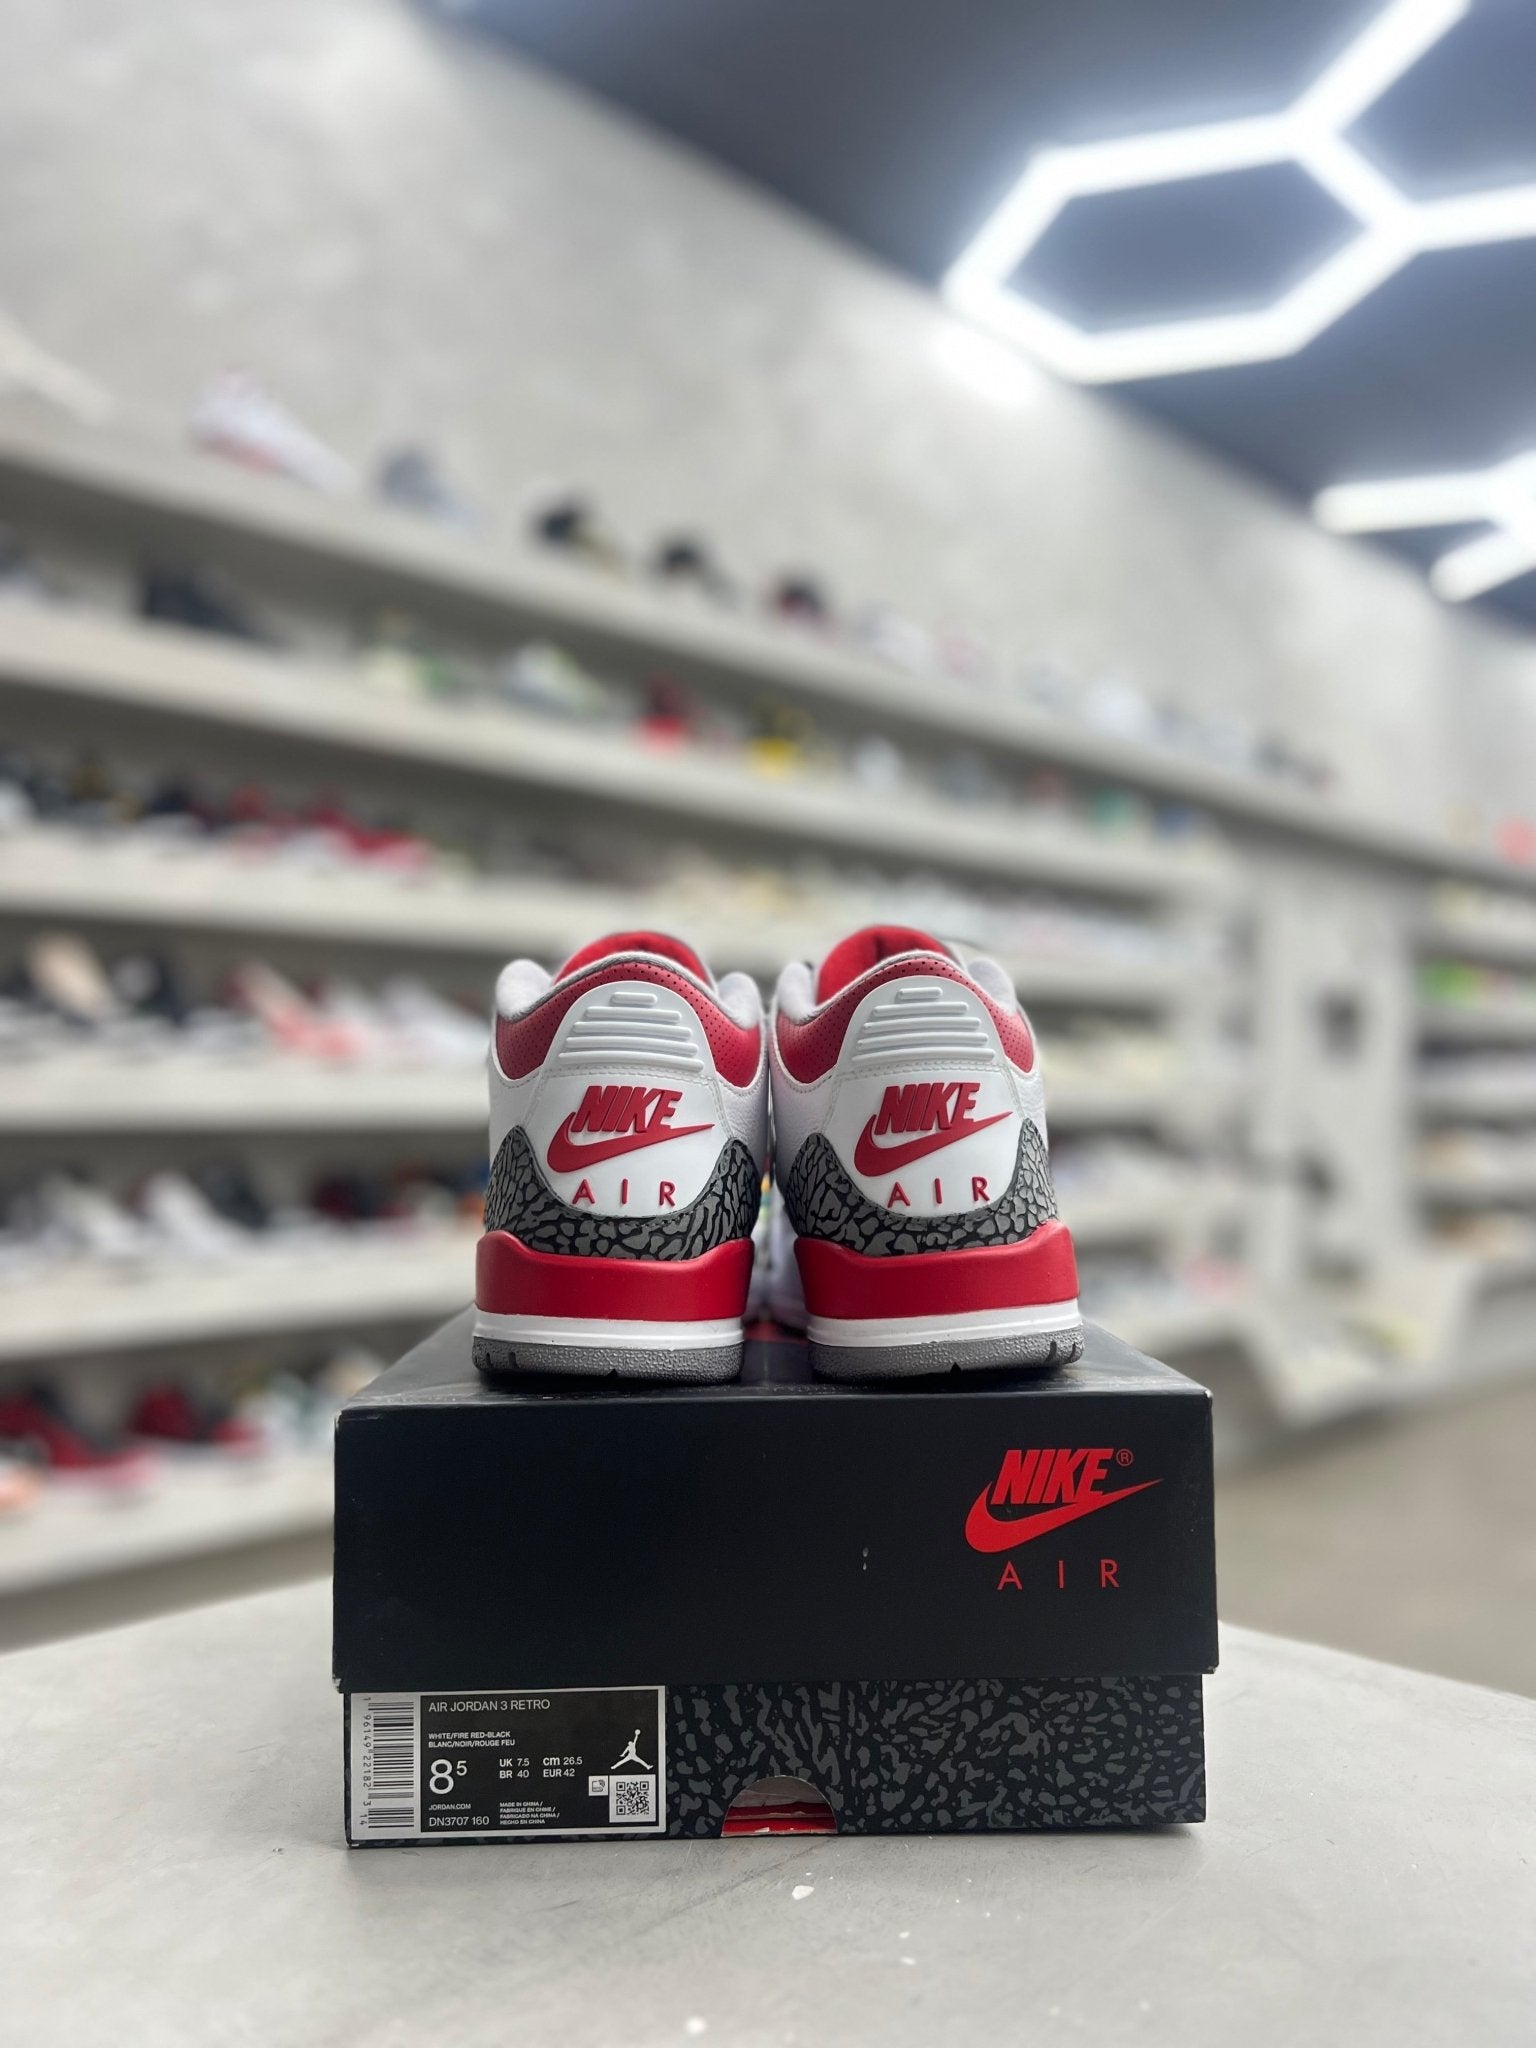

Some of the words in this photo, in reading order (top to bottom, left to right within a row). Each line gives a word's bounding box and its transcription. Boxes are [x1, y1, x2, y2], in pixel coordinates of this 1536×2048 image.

[571, 1085, 683, 1134] NIKE
[874, 1082, 981, 1135] NIKE
[571, 1178, 676, 1207] AIR
[887, 1176, 990, 1209] AIR
[996, 1559, 1120, 1591] AIR
[428, 1701, 448, 1713] AIR
[450, 1700, 498, 1712] JORDAN
[500, 1700, 508, 1711] 3
[510, 1699, 551, 1711] RETRO
[470, 1731, 511, 1739] RED-BLACK
[499, 1758, 513, 1767] UK
[542, 1757, 561, 1766] cm
[563, 1756, 583, 1766] 26.5
[499, 1770, 513, 1779] BR
[517, 1769, 530, 1778] 40
[543, 1768, 562, 1777] EUR
[563, 1768, 576, 1777] 42
[428, 1803, 472, 1811] JORDAN.COM
[429, 1817, 469, 1826] DN3707
[472, 1816, 490, 1825] 160
